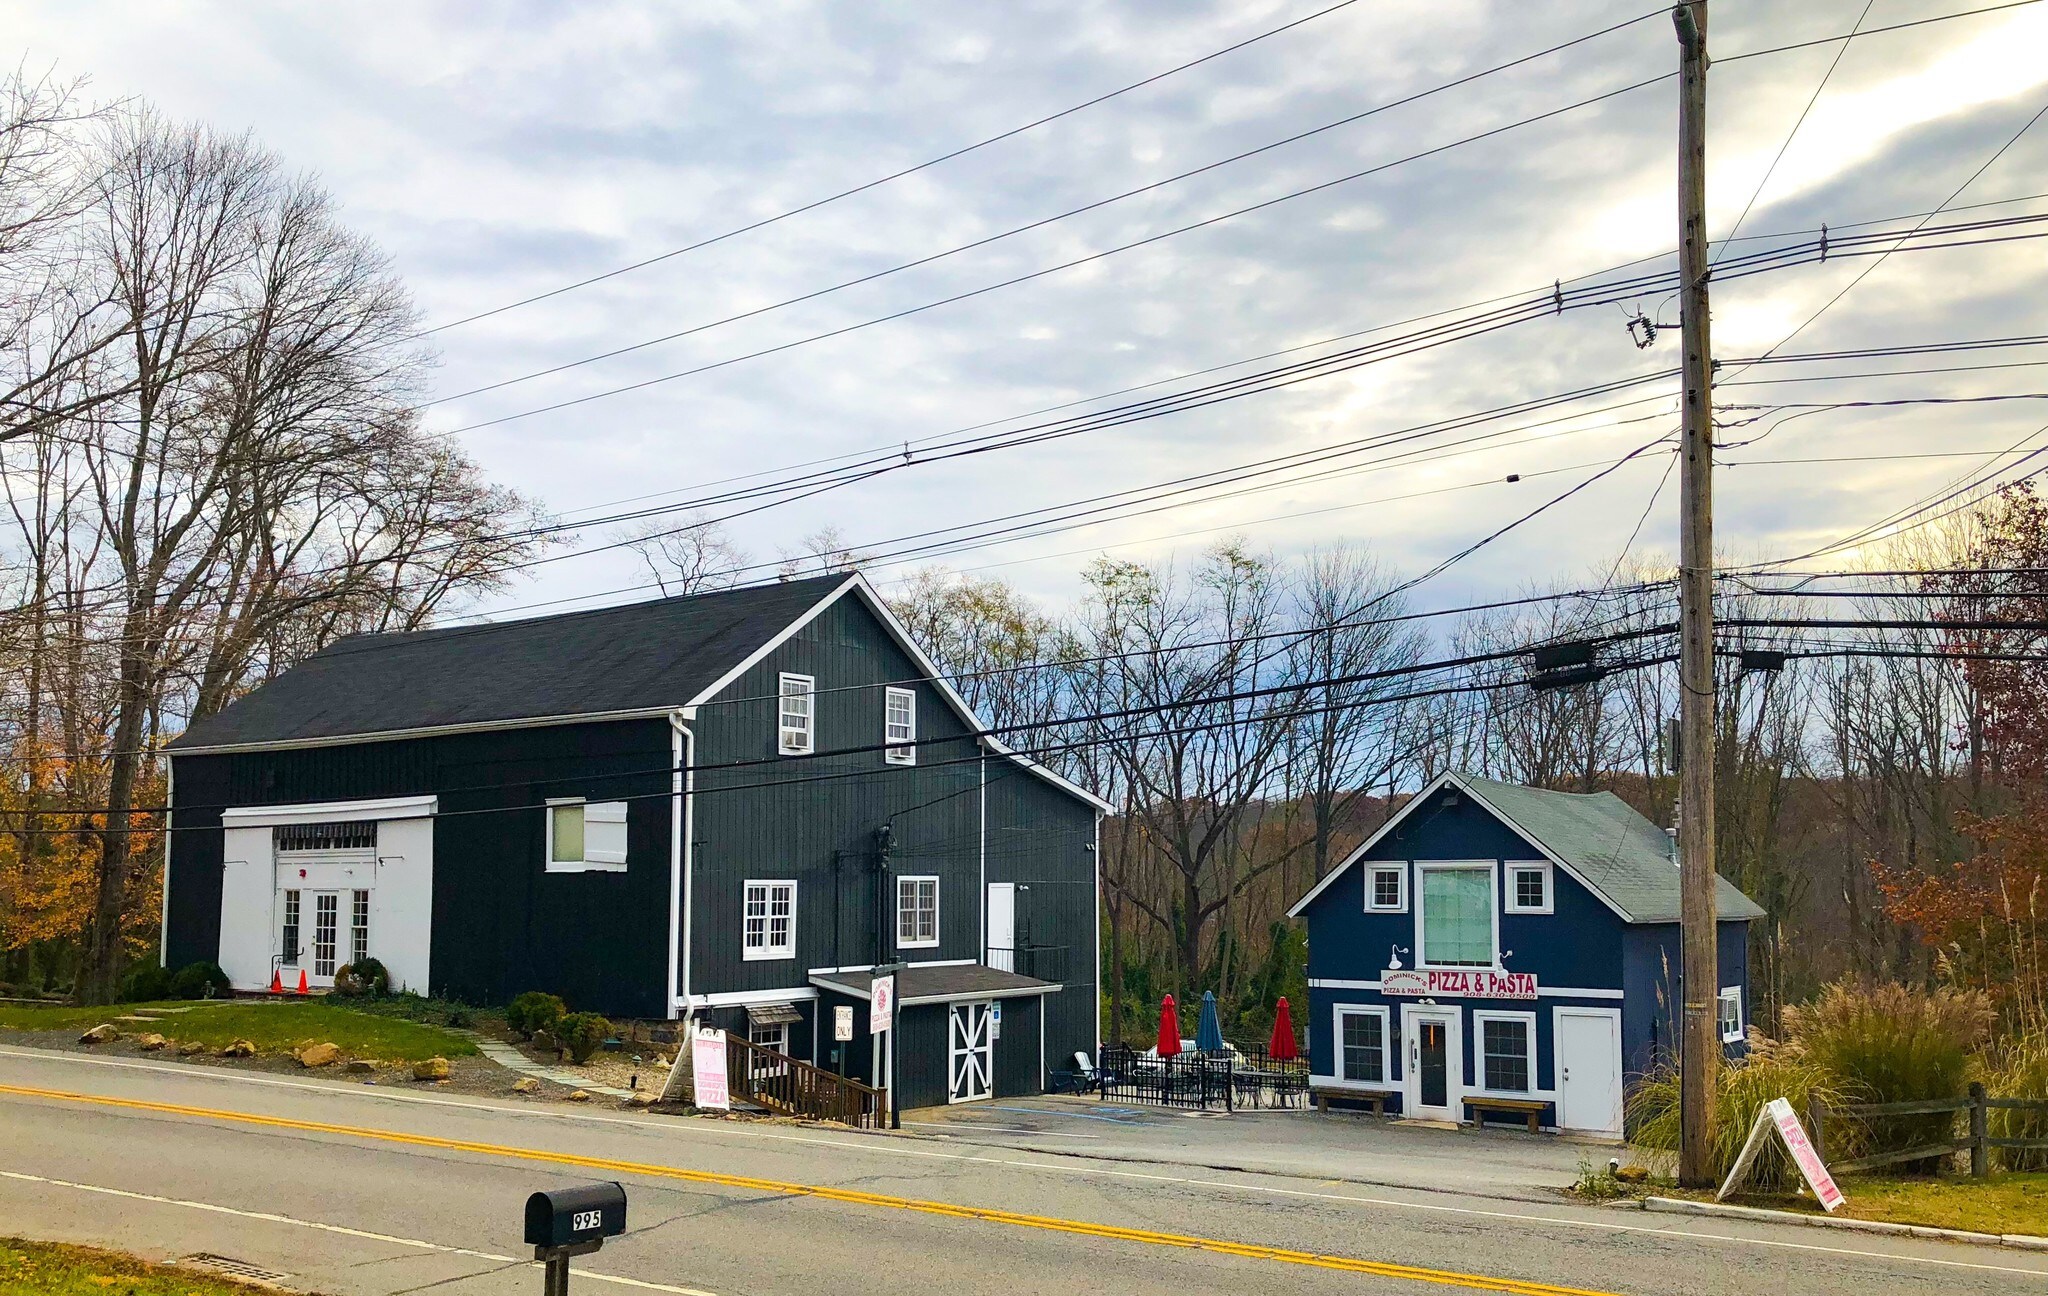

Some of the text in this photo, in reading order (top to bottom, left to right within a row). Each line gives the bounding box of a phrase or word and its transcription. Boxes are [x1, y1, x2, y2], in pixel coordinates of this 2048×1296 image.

[1383, 973, 1427, 987] DOMINICK'S
[1429, 972, 1535, 993] PIZZA & PASTA
[837, 1026, 851, 1036] ONLY
[574, 1212, 600, 1229] 995
